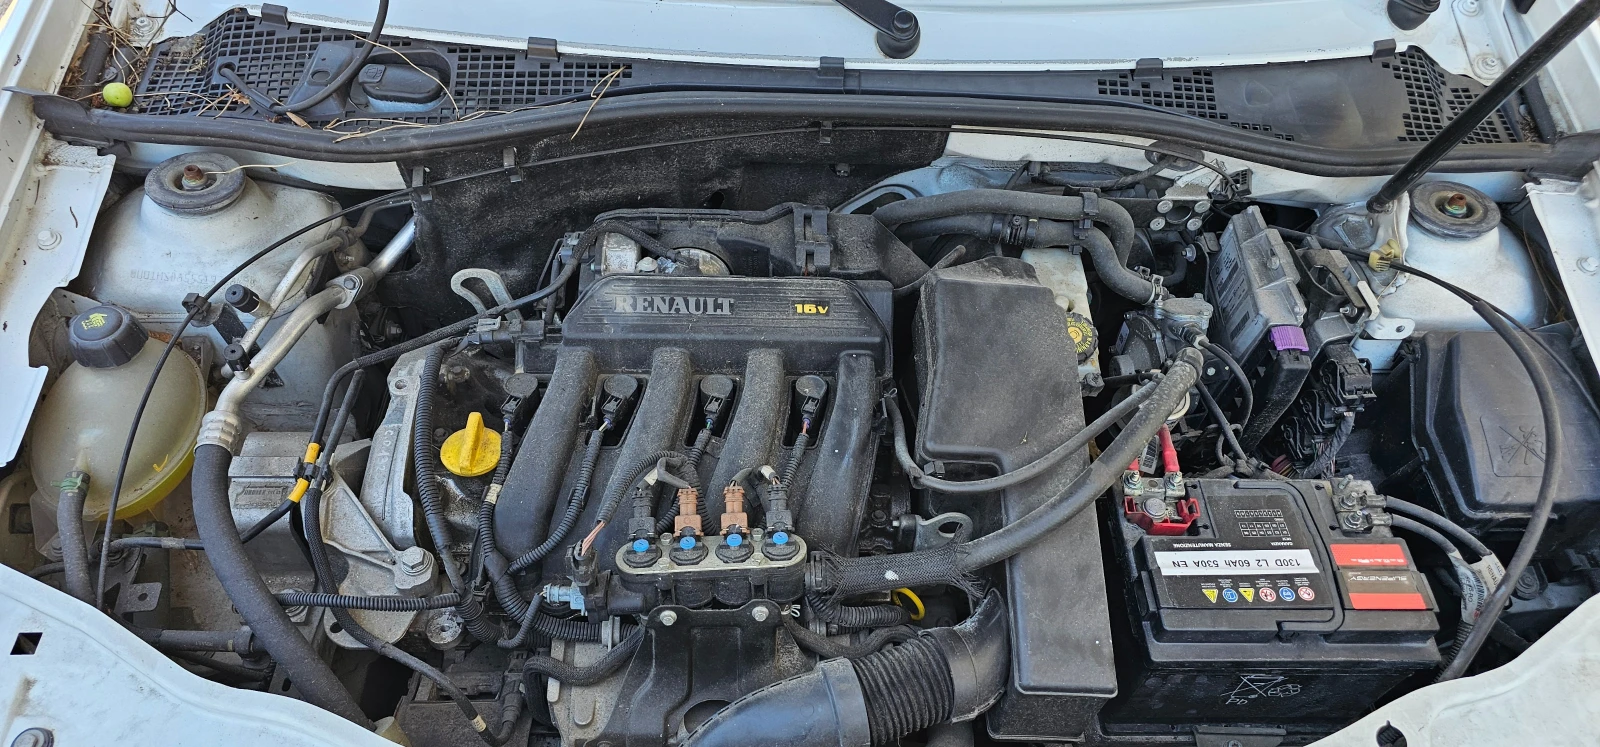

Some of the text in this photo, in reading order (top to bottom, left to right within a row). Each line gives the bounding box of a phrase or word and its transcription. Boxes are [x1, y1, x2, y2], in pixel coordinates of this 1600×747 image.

[613, 295, 734, 316] RENAULT
[1172, 559, 1300, 568] 130D L2 60Ah 530A EN
[1486, 564, 1499, 586] RENAU
